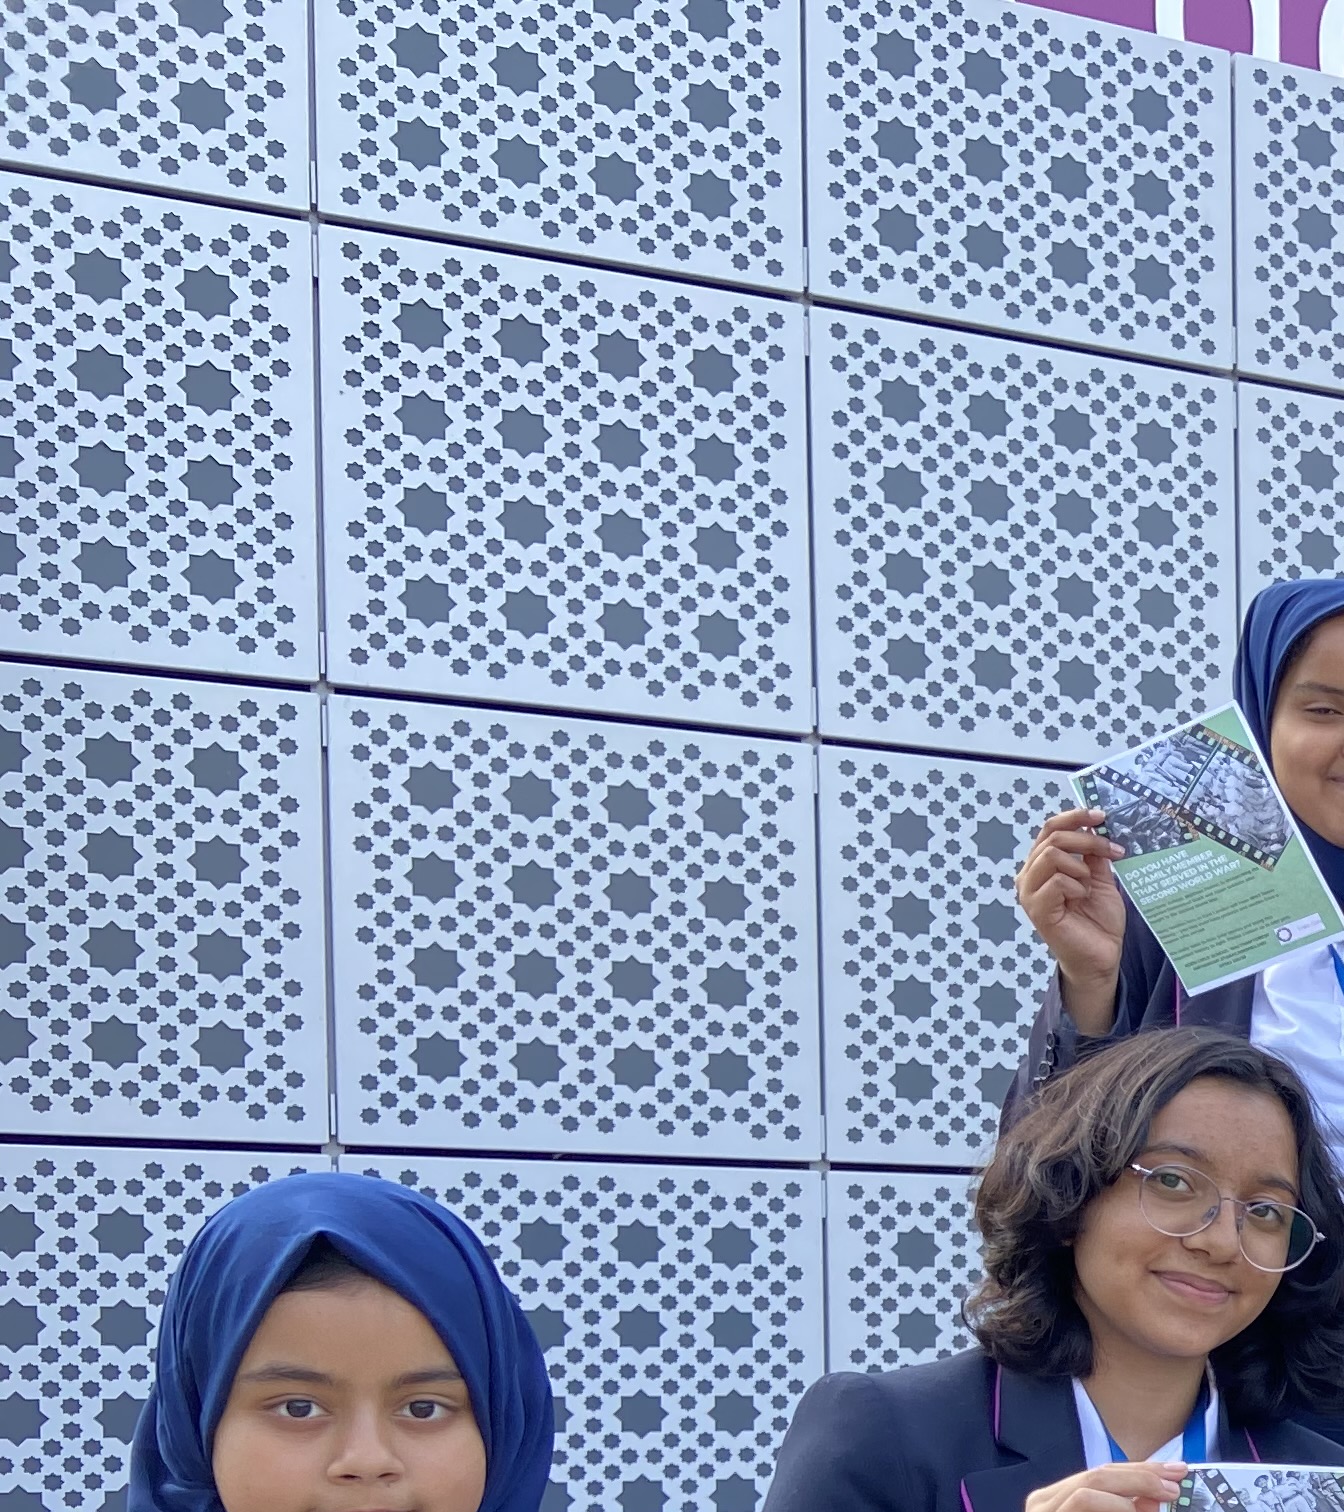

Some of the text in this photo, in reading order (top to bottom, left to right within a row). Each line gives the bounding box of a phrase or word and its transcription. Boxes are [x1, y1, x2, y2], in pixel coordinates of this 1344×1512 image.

[1125, 850, 1189, 880] DO YOU HAVE
[1130, 850, 1213, 890] A FAMILY MEMBER
[1134, 855, 1228, 897] THAT SERVED IN THE
[1140, 860, 1240, 906] SECOND WORLD WAR?
